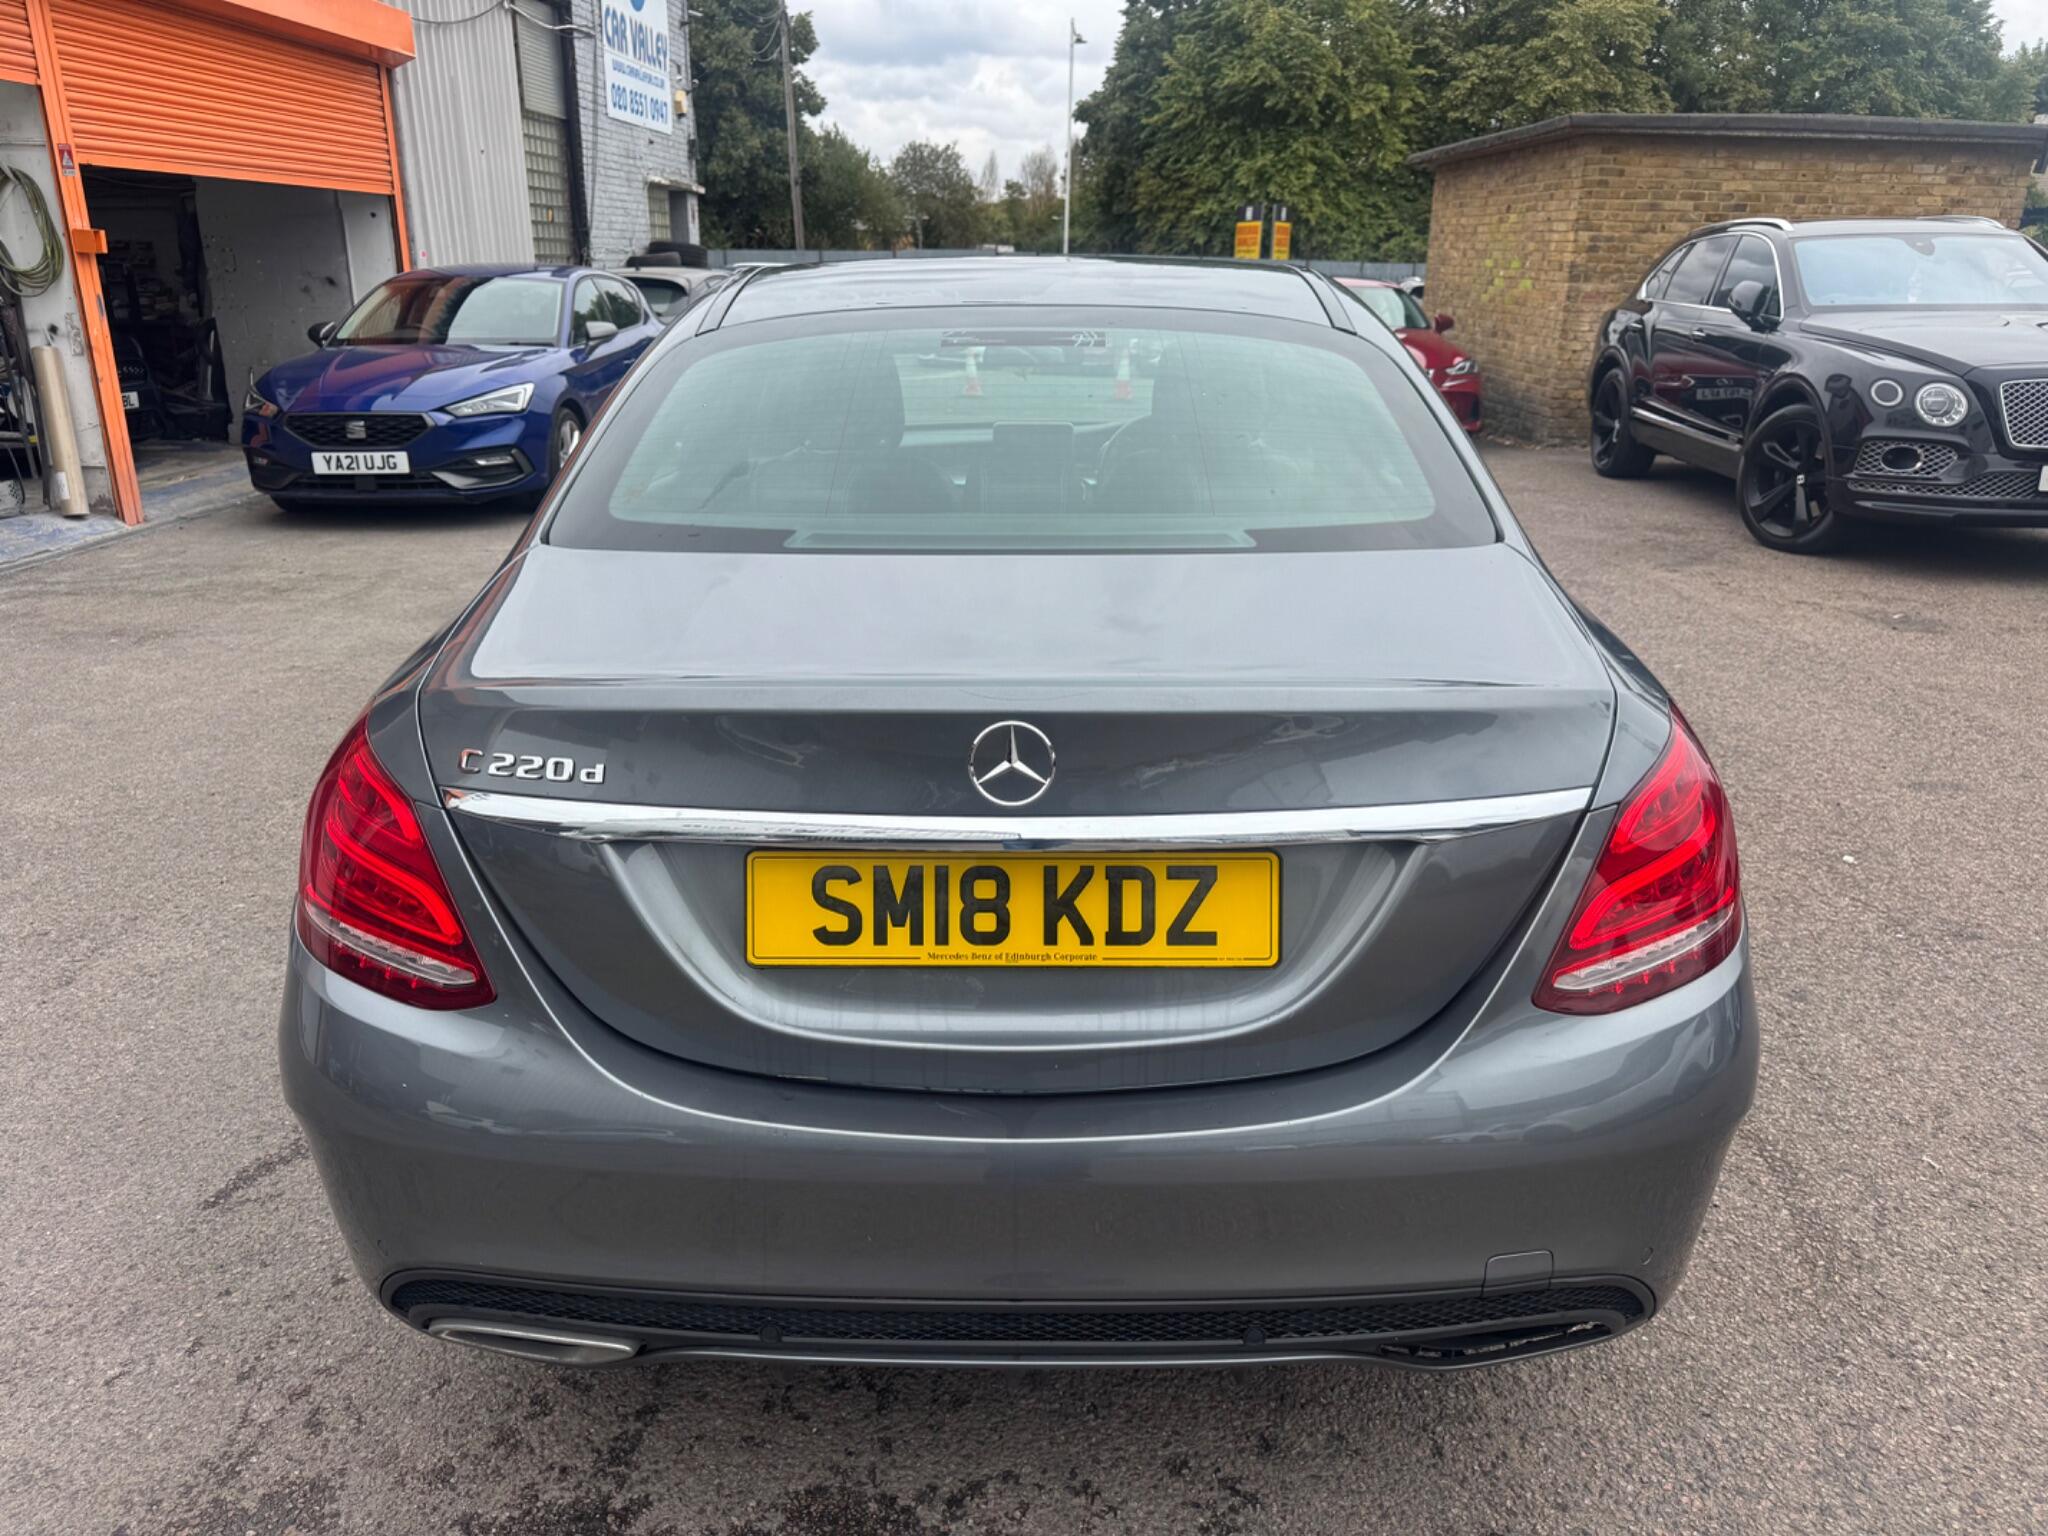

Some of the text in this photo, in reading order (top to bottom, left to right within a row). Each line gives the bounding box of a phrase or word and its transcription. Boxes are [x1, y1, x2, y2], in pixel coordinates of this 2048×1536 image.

[604, 7, 668, 72] CAR VALLEY
[611, 82, 627, 112] 020
[323, 454, 397, 471] YA21 UJG
[811, 865, 1219, 946] SM18 KDZ
[994, 951, 1003, 961] of
[1005, 951, 1052, 963] Edinburgh
[1053, 951, 1098, 963] Corporate
